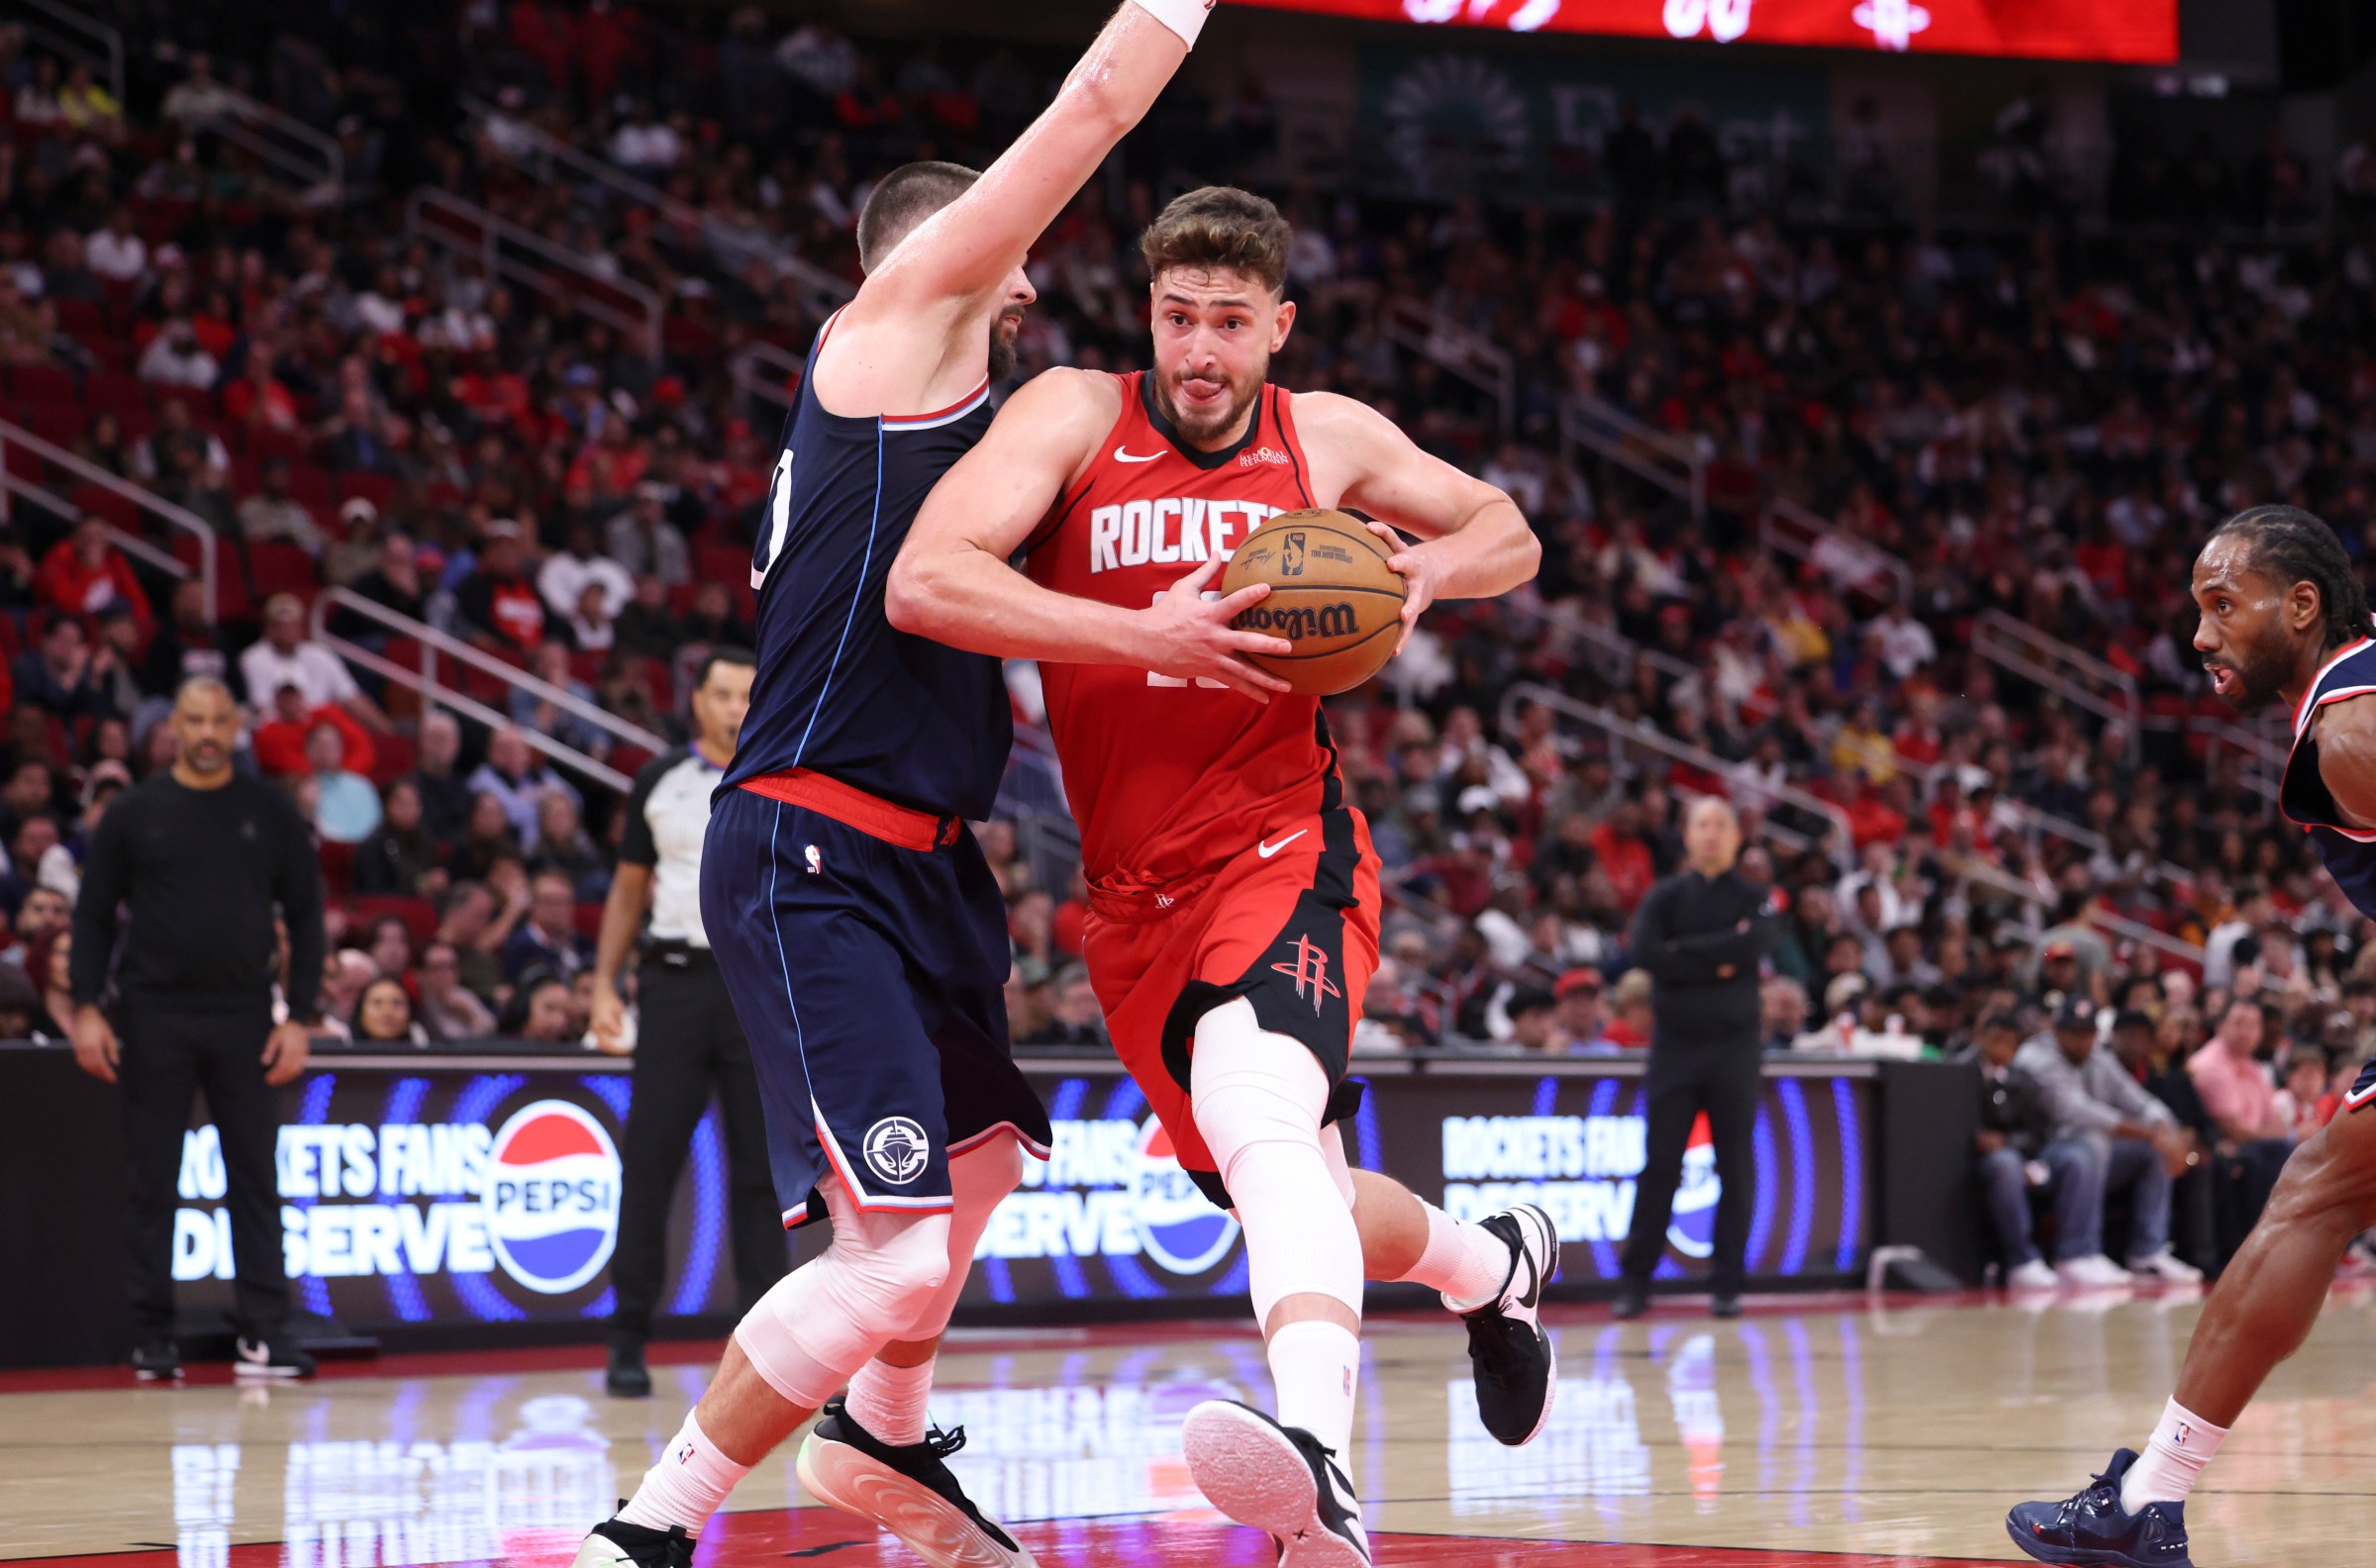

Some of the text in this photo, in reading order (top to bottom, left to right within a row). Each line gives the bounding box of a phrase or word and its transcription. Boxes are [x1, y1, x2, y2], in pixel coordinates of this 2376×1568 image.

[1091, 496, 1288, 575] ROCKET
[1236, 602, 1360, 641] Wilson
[177, 1123, 495, 1200] ROETS FANS
[1586, 1115, 1647, 1177] FAN
[497, 1179, 610, 1213] PEPSI
[1444, 1179, 1637, 1242] DEERV
